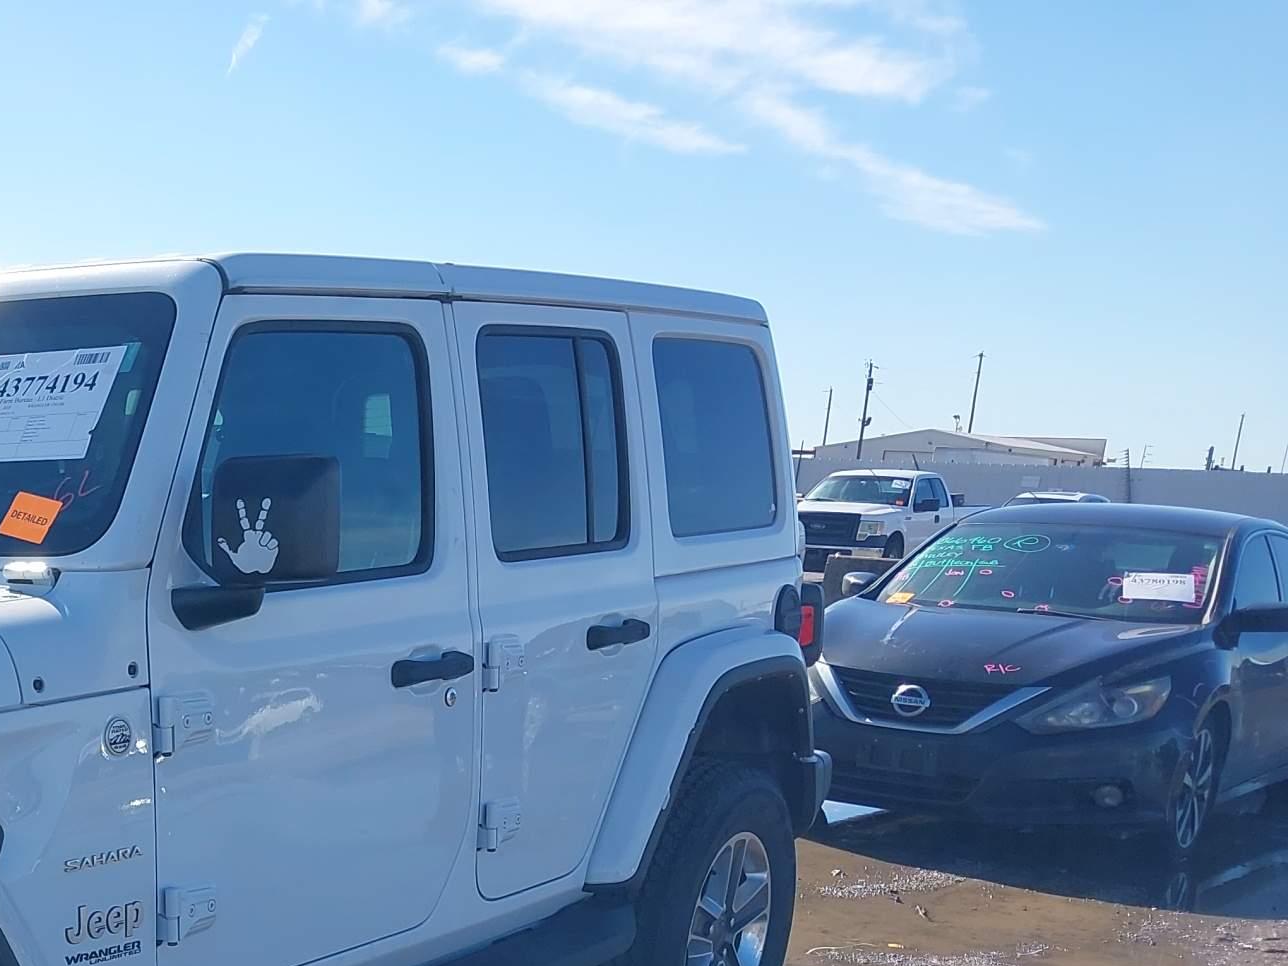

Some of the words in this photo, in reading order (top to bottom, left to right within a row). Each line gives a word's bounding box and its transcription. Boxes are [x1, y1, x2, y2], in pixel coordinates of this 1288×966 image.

[10, 509, 50, 527] DETAILED
[893, 695, 926, 706] NISSAN
[64, 845, 143, 873] SAHARA
[65, 900, 144, 945] Jeep
[65, 940, 141, 966] WRANGLER
[89, 950, 142, 965] UNLIMITED
